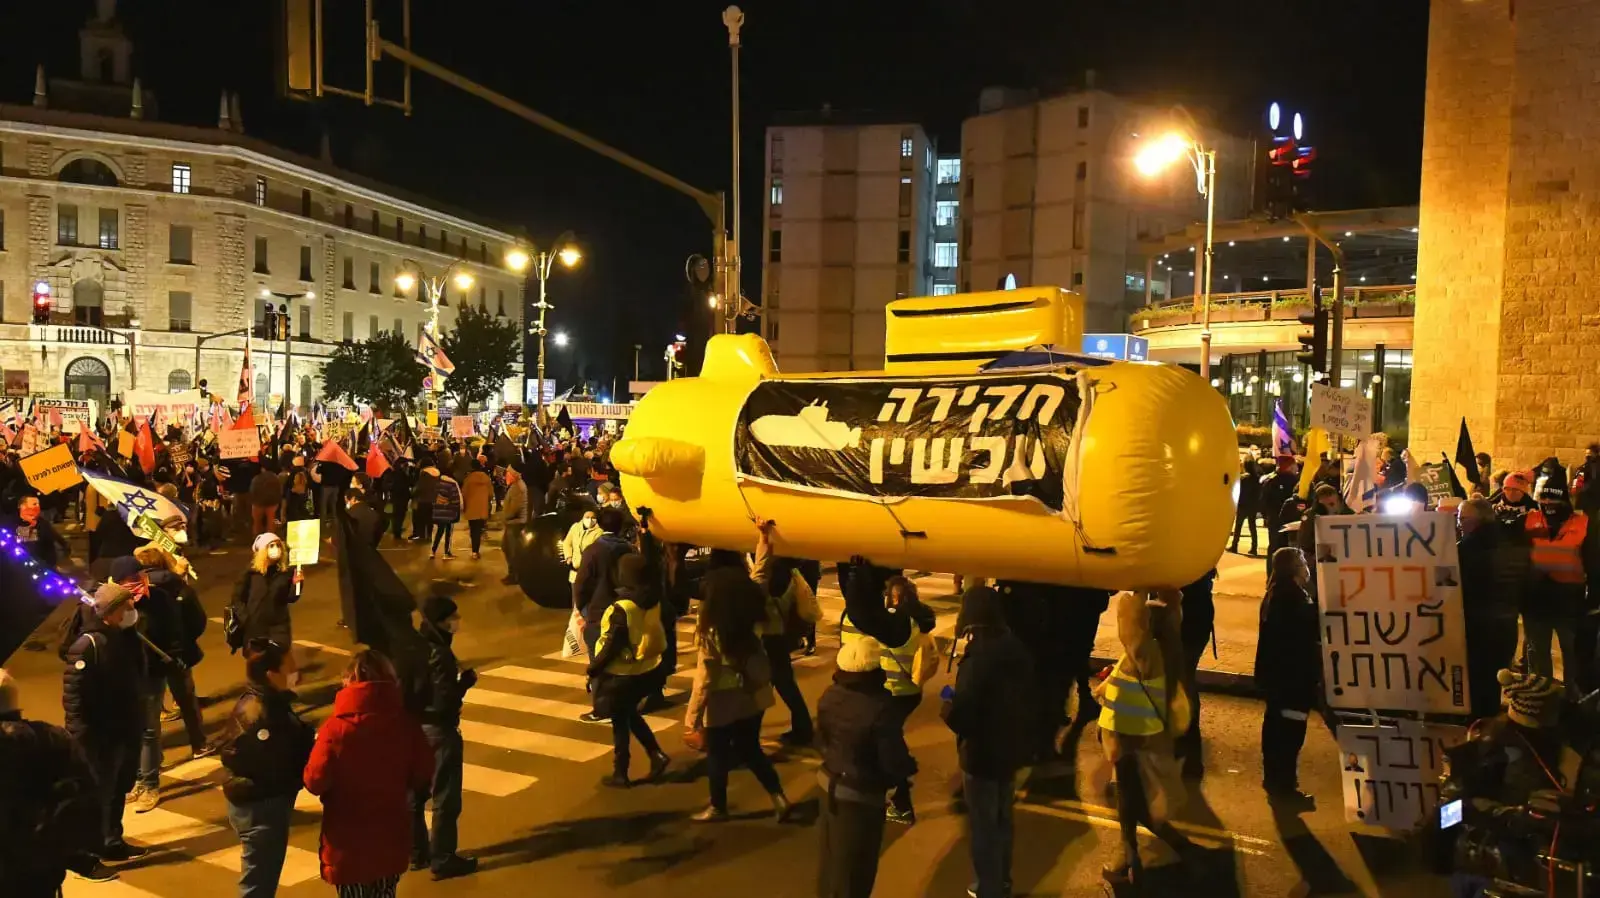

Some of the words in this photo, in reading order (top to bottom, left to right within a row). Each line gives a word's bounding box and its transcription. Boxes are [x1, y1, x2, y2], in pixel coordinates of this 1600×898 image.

[877, 384, 1065, 433] חקירה
[1330, 522, 1436, 557] אהוד
[1338, 566, 1433, 607] ברק
[1324, 600, 1444, 646] לשנה
[1330, 651, 1450, 696] אחת!
[1356, 735, 1447, 770] ובר
